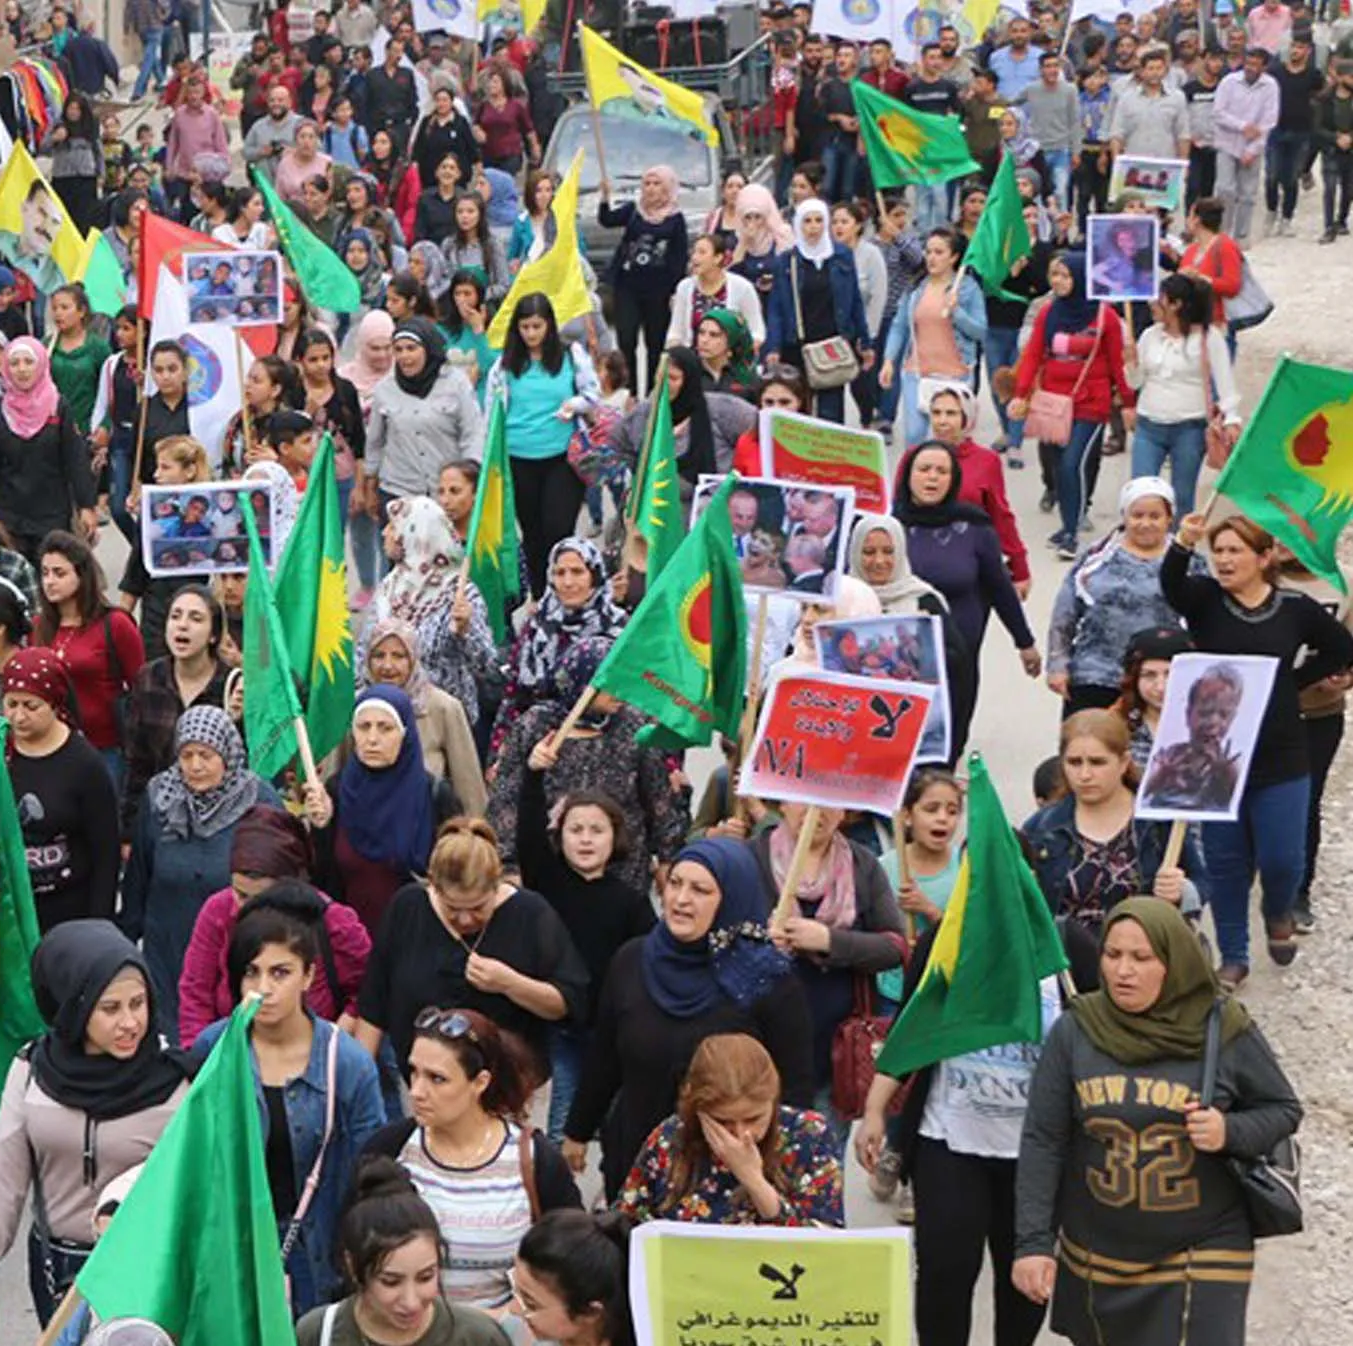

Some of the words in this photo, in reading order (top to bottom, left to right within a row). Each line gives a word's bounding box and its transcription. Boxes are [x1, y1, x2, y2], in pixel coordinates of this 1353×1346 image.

[1075, 1075, 1128, 1109] NEW
[1084, 1117, 1201, 1212] 32
[759, 1262, 805, 1301] لا
